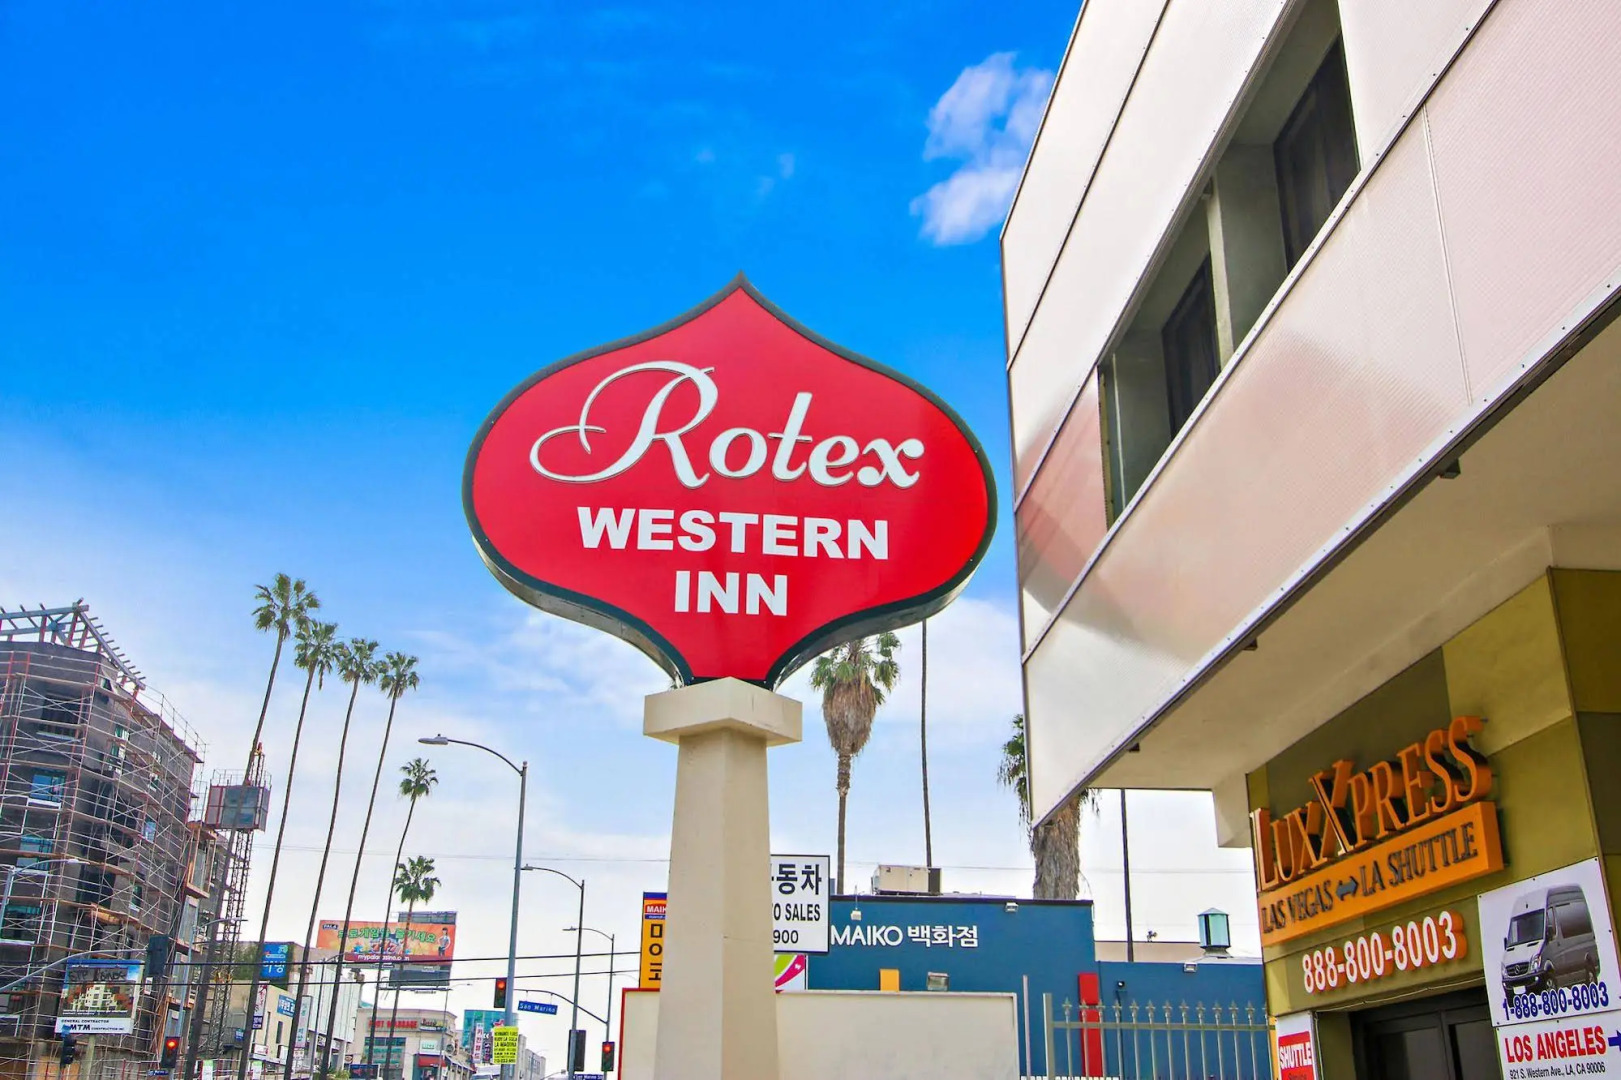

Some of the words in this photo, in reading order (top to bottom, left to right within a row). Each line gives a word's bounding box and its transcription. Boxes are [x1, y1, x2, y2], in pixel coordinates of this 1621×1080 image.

[530, 360, 925, 489] Rotex
[577, 506, 889, 560] WESTERN
[673, 570, 788, 616] INN
[772, 863, 822, 895] 동차
[1261, 905, 1286, 934] LAS
[1288, 879, 1334, 922] VEGAS
[1359, 860, 1386, 897] LA
[1387, 821, 1479, 887] SHUTTLE
[785, 903, 821, 921] SALES
[830, 924, 904, 946] MAIKO
[907, 925, 979, 948] 백화점
[1302, 911, 1457, 994] 888-800-8003
[519, 1001, 531, 1010] San
[534, 1003, 556, 1013] Marino
[1502, 981, 1609, 1021] 1-888-800-8003
[368, 1020, 385, 1028] FOT
[1279, 1041, 1313, 1070] SHUTTLE
[1504, 1035, 1533, 1063] LOS
[1537, 1025, 1607, 1061] ANGELES
[1509, 1069, 1519, 1080] 921
[1520, 1068, 1527, 1079] S.
[1527, 1066, 1550, 1078] Western
[1576, 1063, 1587, 1075] CA
[1587, 1061, 1606, 1074] 90006
